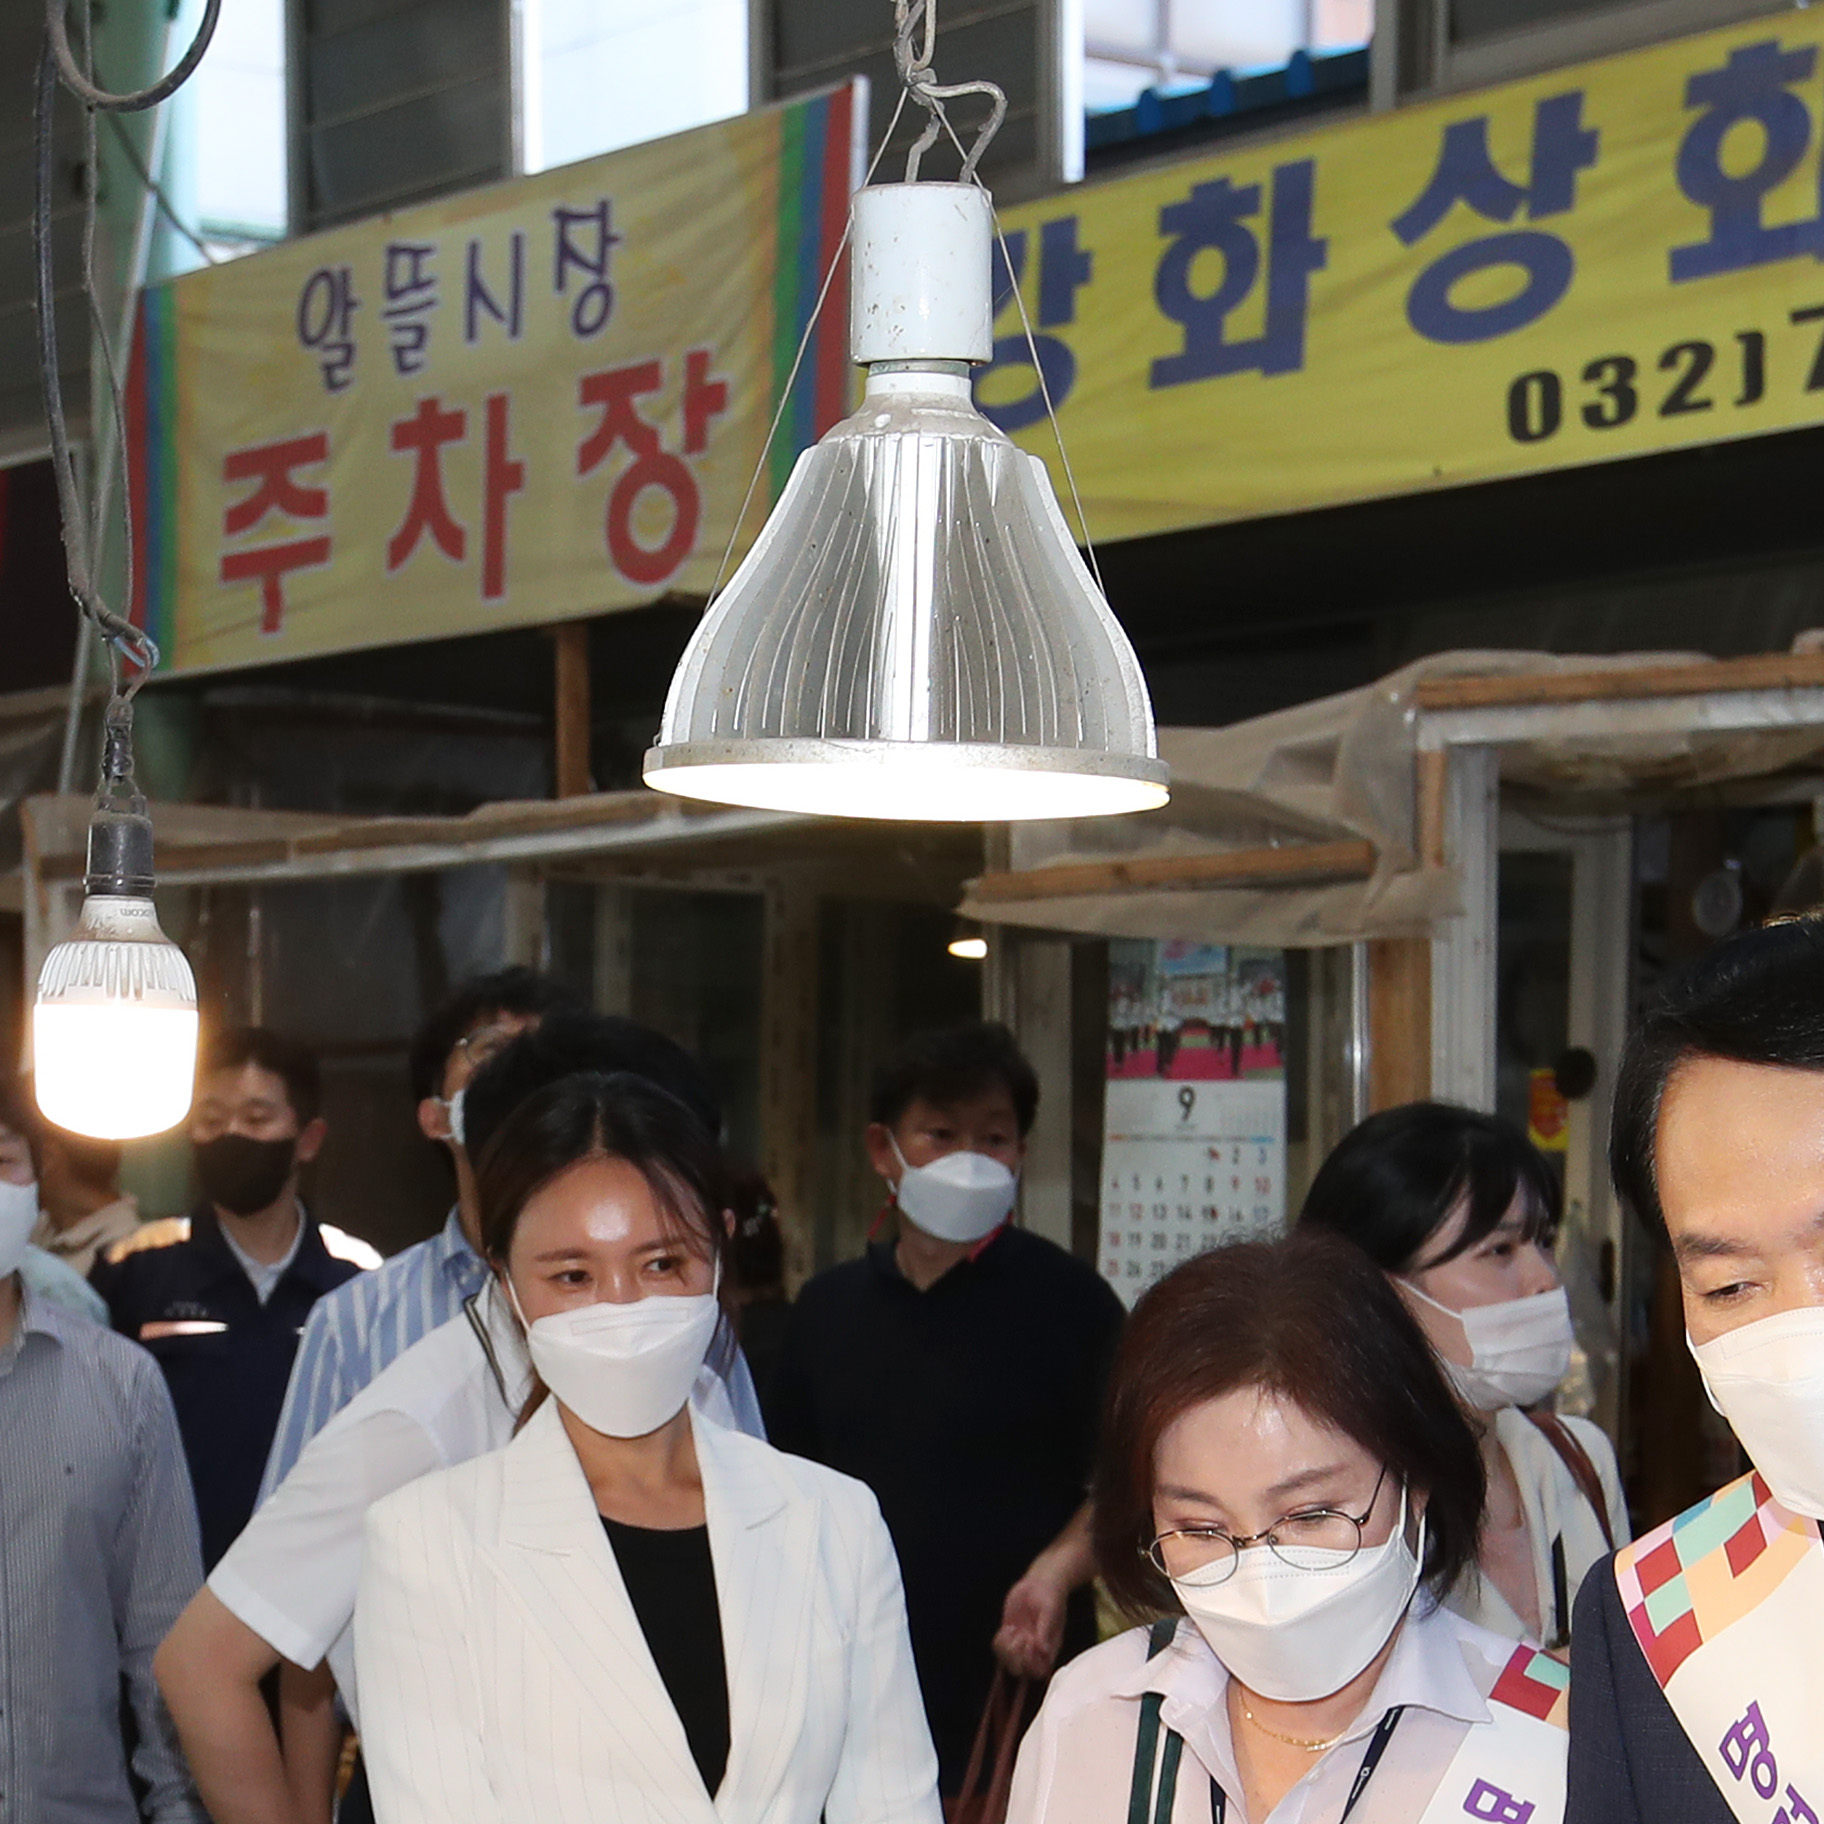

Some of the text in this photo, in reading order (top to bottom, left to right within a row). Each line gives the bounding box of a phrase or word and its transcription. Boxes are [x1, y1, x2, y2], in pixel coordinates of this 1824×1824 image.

[296, 199, 625, 392] 알뜰시장
[219, 350, 730, 637] 주차장
[1177, 1086, 1196, 1122] 9
